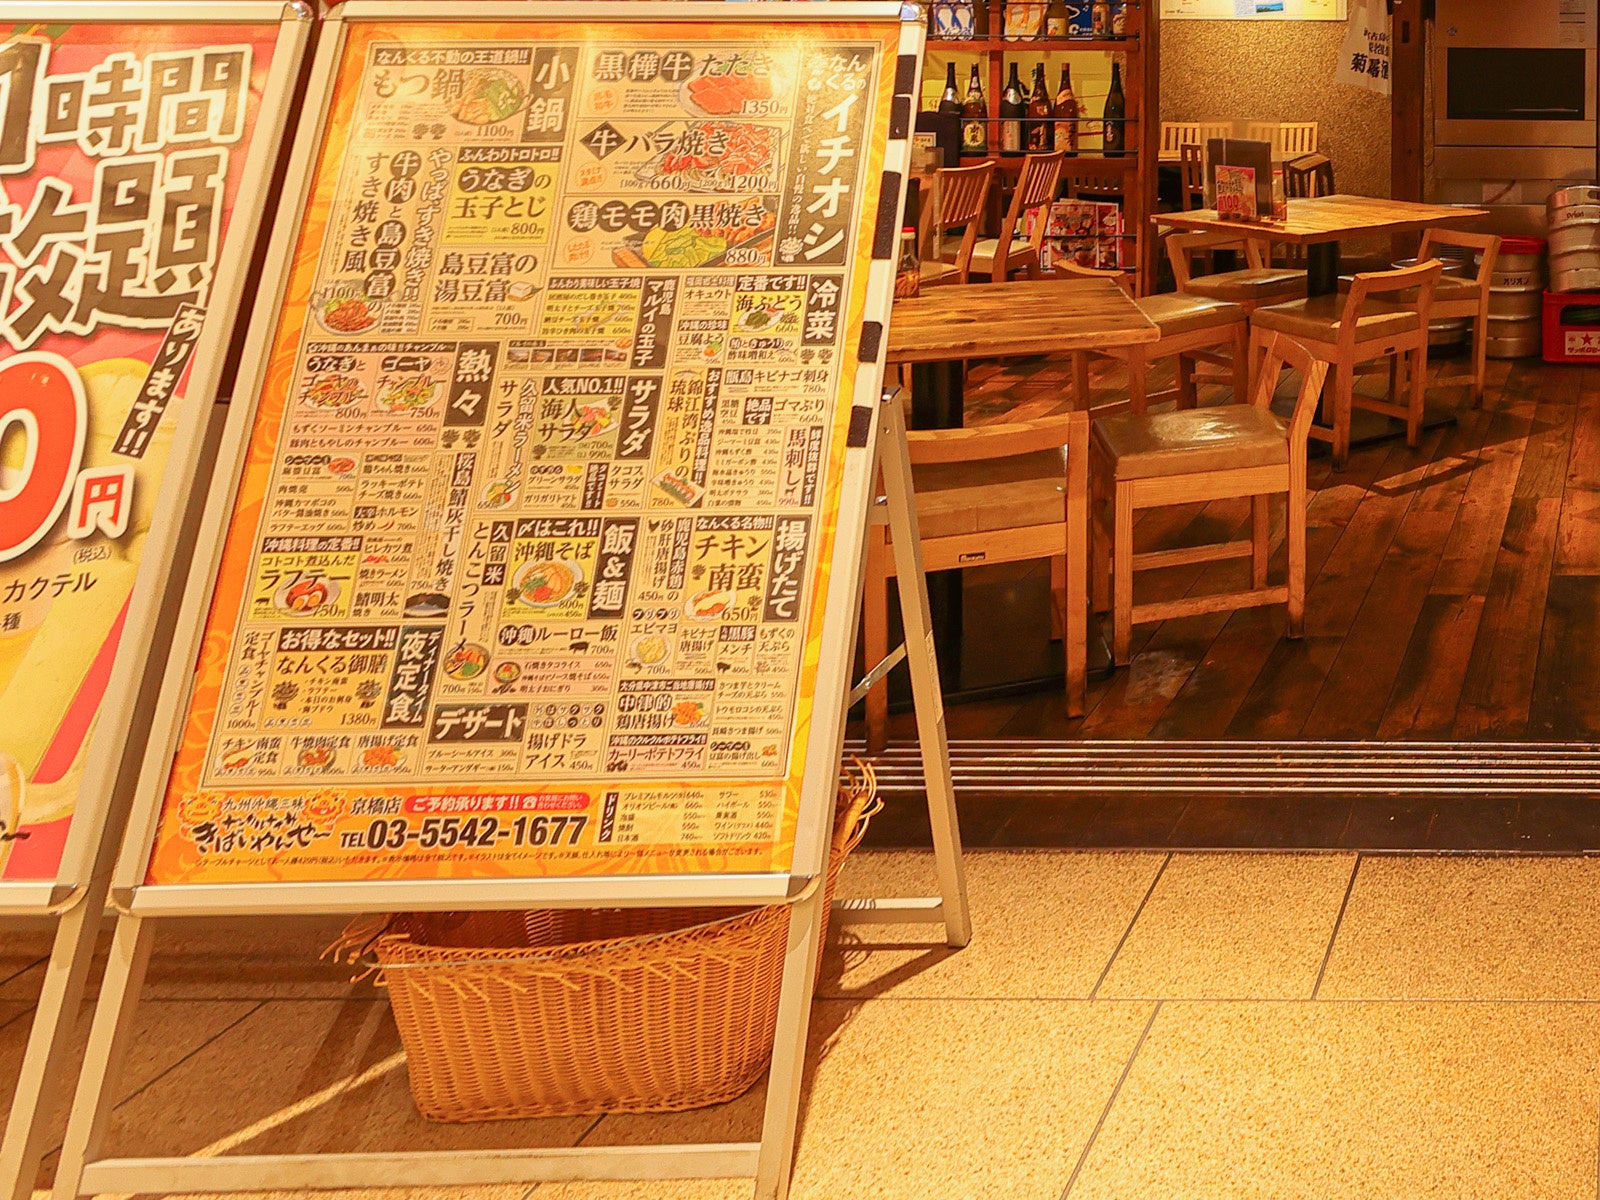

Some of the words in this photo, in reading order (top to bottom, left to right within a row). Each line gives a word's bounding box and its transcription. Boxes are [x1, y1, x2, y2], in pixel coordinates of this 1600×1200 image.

[376, 49, 529, 65] なんくる不動の王道鍋!!
[595, 52, 773, 81] 黒樺牛たたき
[373, 68, 464, 100] もつ鍋
[526, 53, 571, 133] 小鍋
[740, 99, 788, 115] 1350円
[589, 128, 730, 157] 牛バラ焼き
[457, 148, 560, 163] ふんわりトロトロ!!
[461, 166, 552, 192] うなぎの
[804, 93, 860, 261] イチオシ
[341, 151, 390, 274] すき焼き風
[451, 196, 546, 220] 玉子とじ
[570, 202, 767, 229] 鶏モモ肉黒焼き
[510, 223, 545, 235] 800円
[438, 251, 538, 277] 島豆富の
[725, 250, 767, 264] 880円
[434, 279, 508, 302] 湯豆富
[737, 275, 806, 291] 定番です!!
[1503, 277, 1529, 286] オリオン
[658, 280, 676, 316] 鹿児島
[735, 294, 802, 313] 海ぶどう
[804, 279, 840, 340] 冷菜
[494, 313, 528, 326] 700円
[634, 280, 664, 367] マルイの玉子
[679, 320, 728, 331] 沖縄の珍味
[307, 356, 366, 373] うなぎと
[383, 356, 430, 372] ゴーヤ
[118, 307, 205, 456] あります!!
[301, 375, 359, 388] ゴーヤの
[376, 375, 447, 389] チャンプルー
[451, 349, 492, 417] 熱々
[543, 377, 623, 395] 人気NO.1!!
[754, 370, 830, 384] キビナゴ刺身
[299, 392, 369, 407] チャンプルー
[667, 379, 687, 413] 琉球
[774, 399, 825, 412] ゴマぶり
[335, 408, 367, 419] 800円
[409, 408, 441, 418] 750円
[491, 379, 518, 440] サラダ
[540, 398, 584, 420] 海人
[619, 380, 657, 457] サラダ
[292, 424, 412, 434] もずくソーミンチャンプルー
[503, 378, 539, 494] 久留米ラーメン
[537, 424, 593, 443] サラダ
[289, 437, 409, 448] 豚肉ともやしのチャンプルー
[784, 428, 808, 487] 馬刺し
[528, 475, 583, 485] グリーンサラダ
[696, 516, 772, 531] なんくる名物!!
[264, 537, 361, 552] 沖縄料理の定番!!
[483, 523, 514, 585] 久留米
[515, 540, 595, 562] 沖縄そば
[694, 534, 770, 561] チキン
[262, 555, 355, 567] コトコト煮込んだ
[591, 523, 637, 612] 飯&麺
[768, 519, 807, 619] 揚げたて
[260, 569, 351, 592] ラフテー
[708, 563, 765, 592] 南蛮
[4, 572, 98, 603] カクテル
[314, 604, 346, 618] 750円
[720, 606, 758, 622] 650円
[500, 625, 619, 645] 沖縄ルーロー飯
[630, 623, 679, 634] エビマヨ
[280, 629, 395, 651] お得なセット!!
[680, 640, 715, 652] 唐揚げ
[718, 644, 752, 655] メンチ
[276, 654, 389, 675] なんくる御膳
[386, 631, 423, 724] 夜定食
[340, 713, 379, 726] 1380円
[435, 705, 522, 740] デザート
[222, 736, 283, 750] チキン南蛮
[289, 736, 352, 749] 牛焼肉定食
[357, 734, 420, 748] 唐揚げ定食
[527, 733, 588, 751] 揚げドラ
[253, 751, 279, 764] 定食
[525, 752, 566, 770] アイス
[608, 747, 704, 761] カーリーポテトフライ
[350, 795, 404, 816] 京橋店
[600, 793, 618, 841] ドリンク
[191, 821, 333, 854] きばいやんせー
[340, 832, 366, 848] TEL
[366, 814, 588, 850] 03-5542-1677
